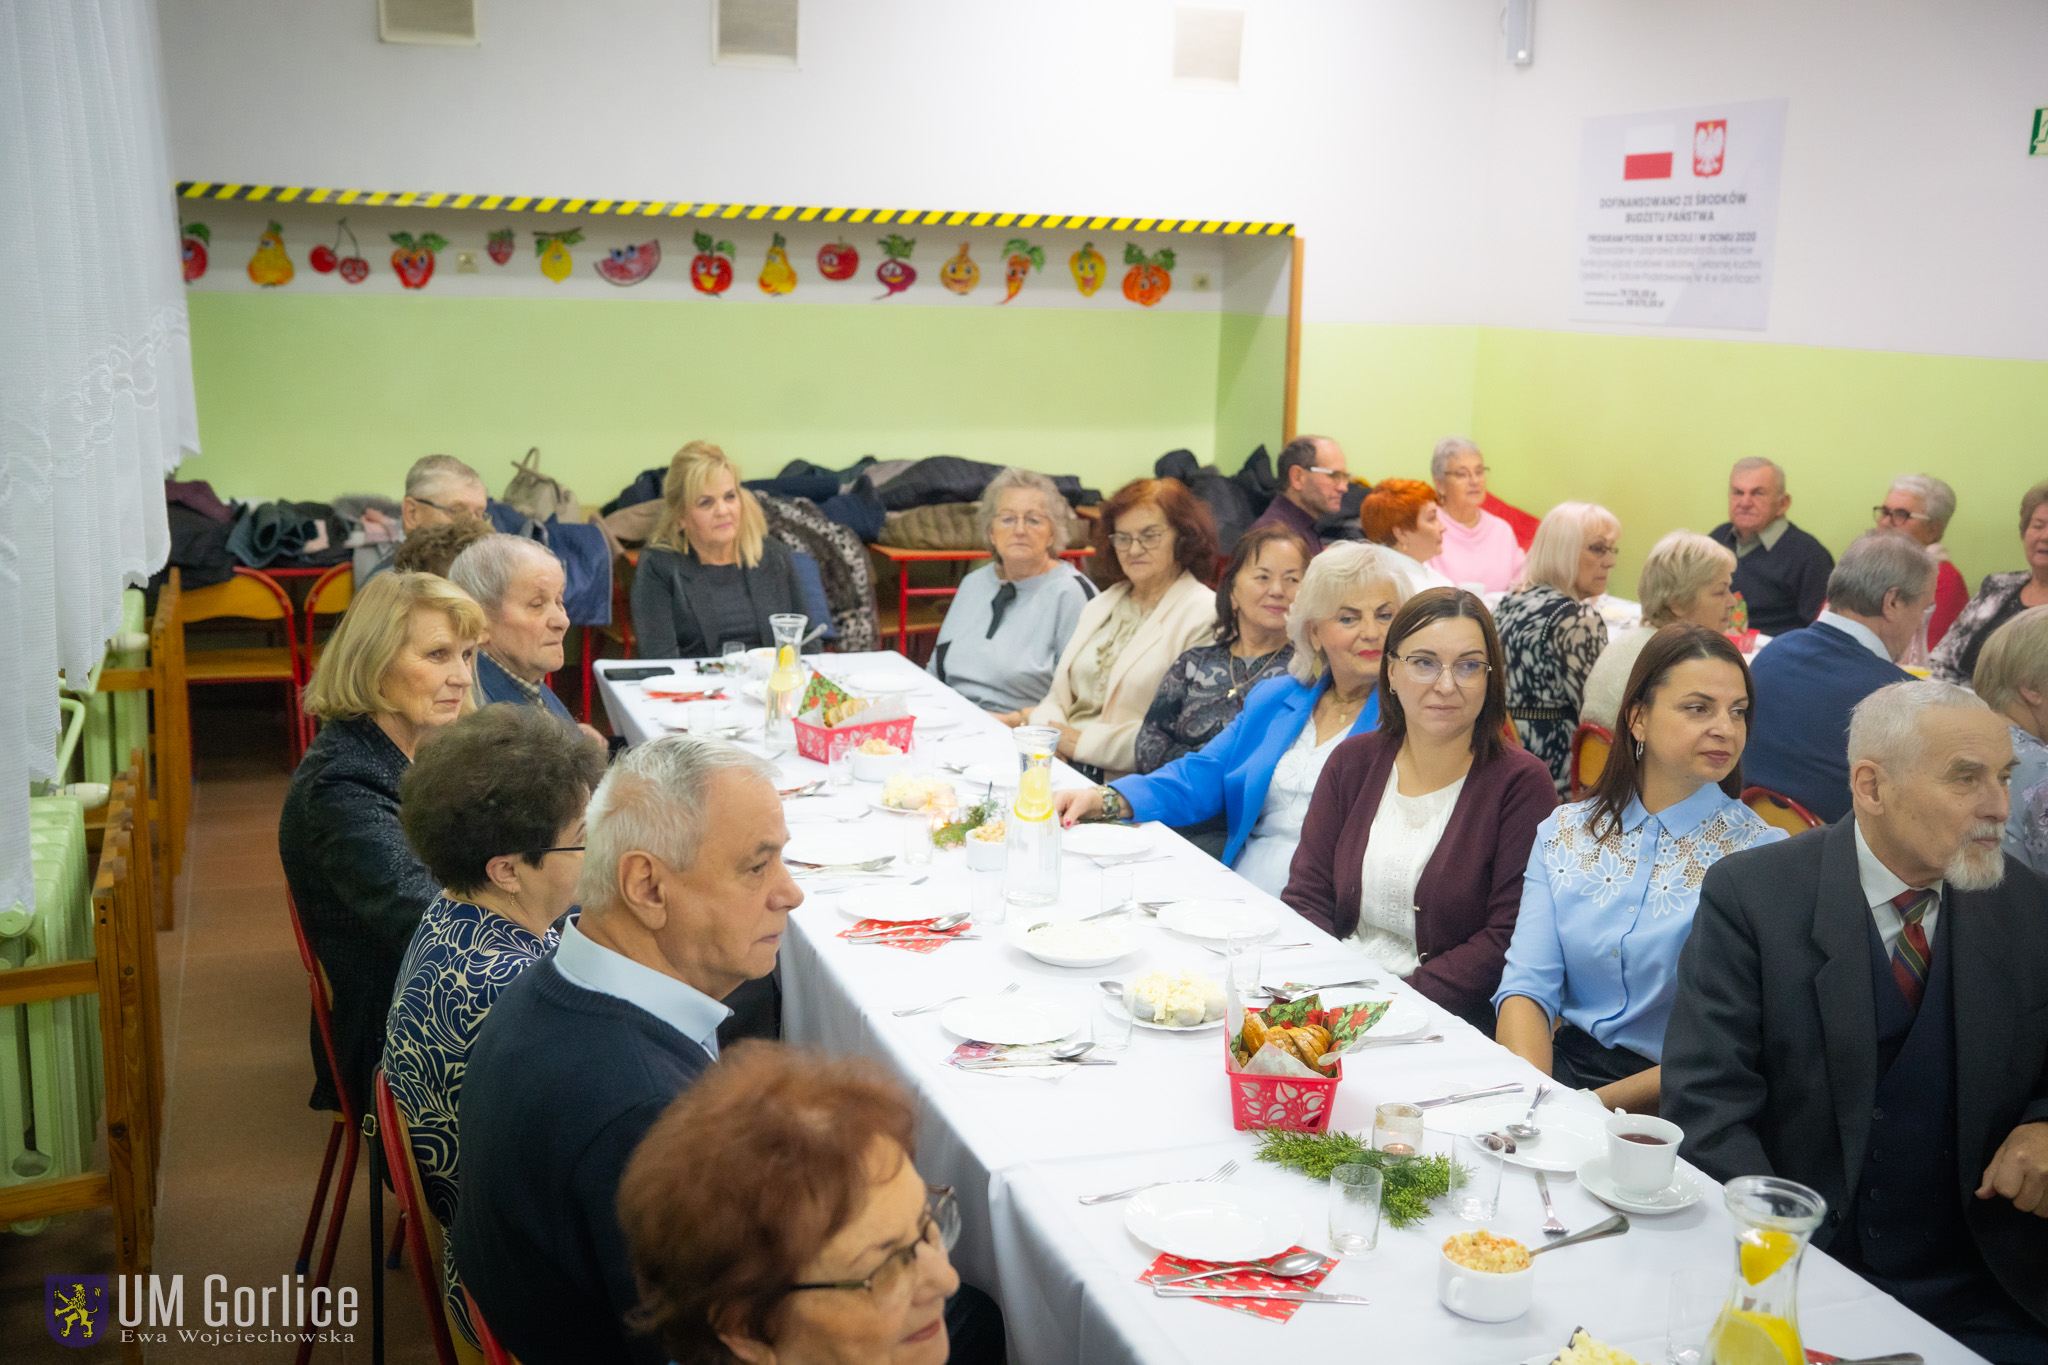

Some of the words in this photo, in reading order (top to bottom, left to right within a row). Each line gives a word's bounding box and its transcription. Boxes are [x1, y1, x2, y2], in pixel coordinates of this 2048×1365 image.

[1599, 195, 1681, 209] DOFINANSOWANO
[1683, 194, 1693, 206] ZE
[1695, 191, 1747, 206] ŚRODKÓW
[1625, 210, 1665, 223] BUDŻETU
[1666, 208, 1714, 222] PAŃSTWA
